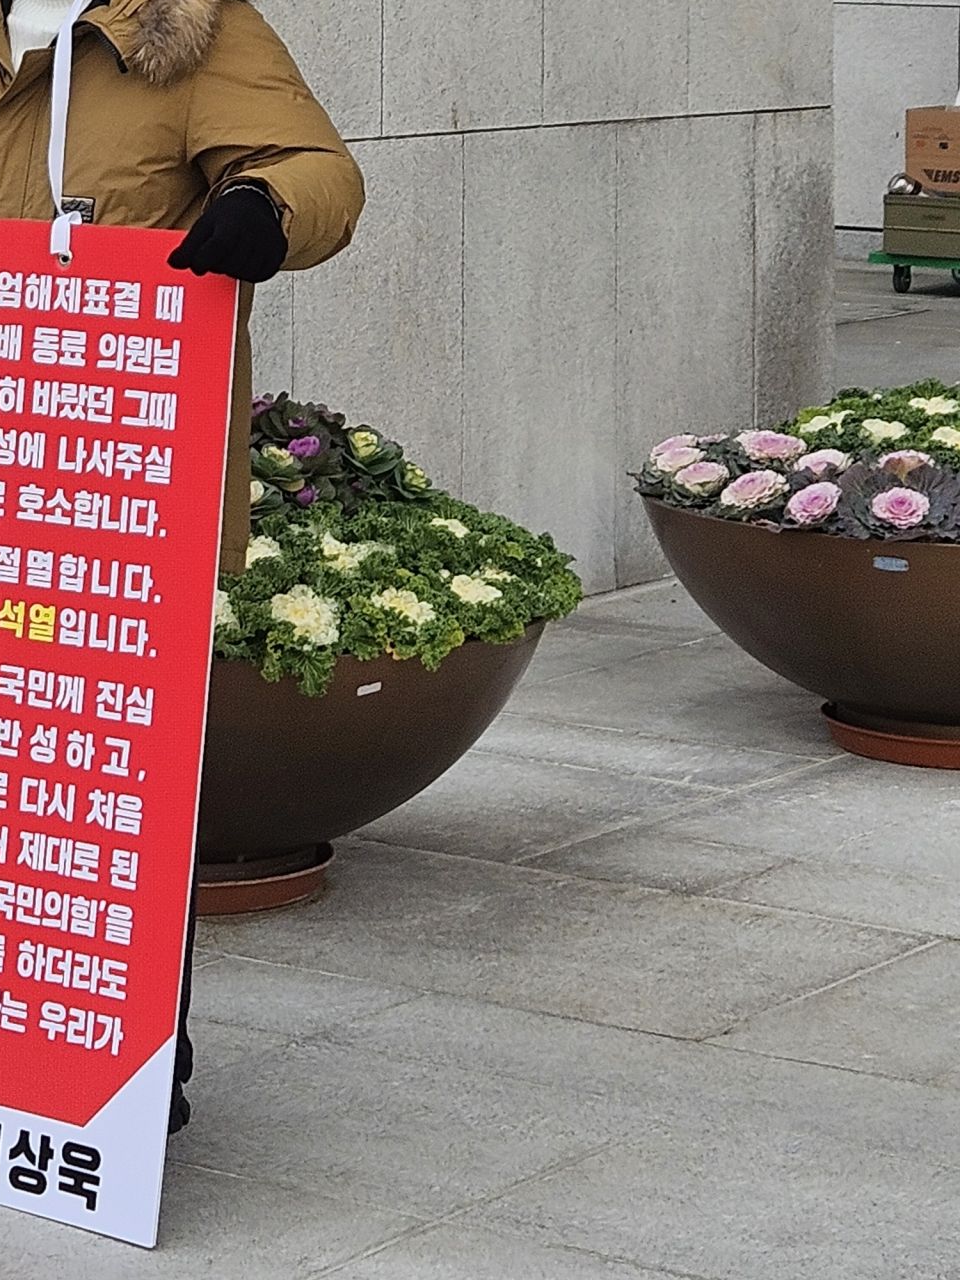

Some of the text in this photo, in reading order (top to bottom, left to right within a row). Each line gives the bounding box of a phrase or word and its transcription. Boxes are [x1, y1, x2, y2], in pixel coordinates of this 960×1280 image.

[155, 285, 185, 324] 때
[32, 326, 87, 367] 동료
[96, 333, 181, 377] 의원님
[31, 379, 115, 424] 바랐던
[120, 388, 177, 431] 그때
[57, 436, 173, 485] 나서주실
[16, 483, 167, 538] 호소합니다.
[95, 680, 154, 727] 진심
[19, 776, 76, 823] 다시
[85, 788, 143, 836] 처음
[16, 831, 100, 883] 제대로
[109, 848, 139, 891] 된
[16, 939, 128, 1001] 하더라도
[38, 1000, 124, 1056] 우리가
